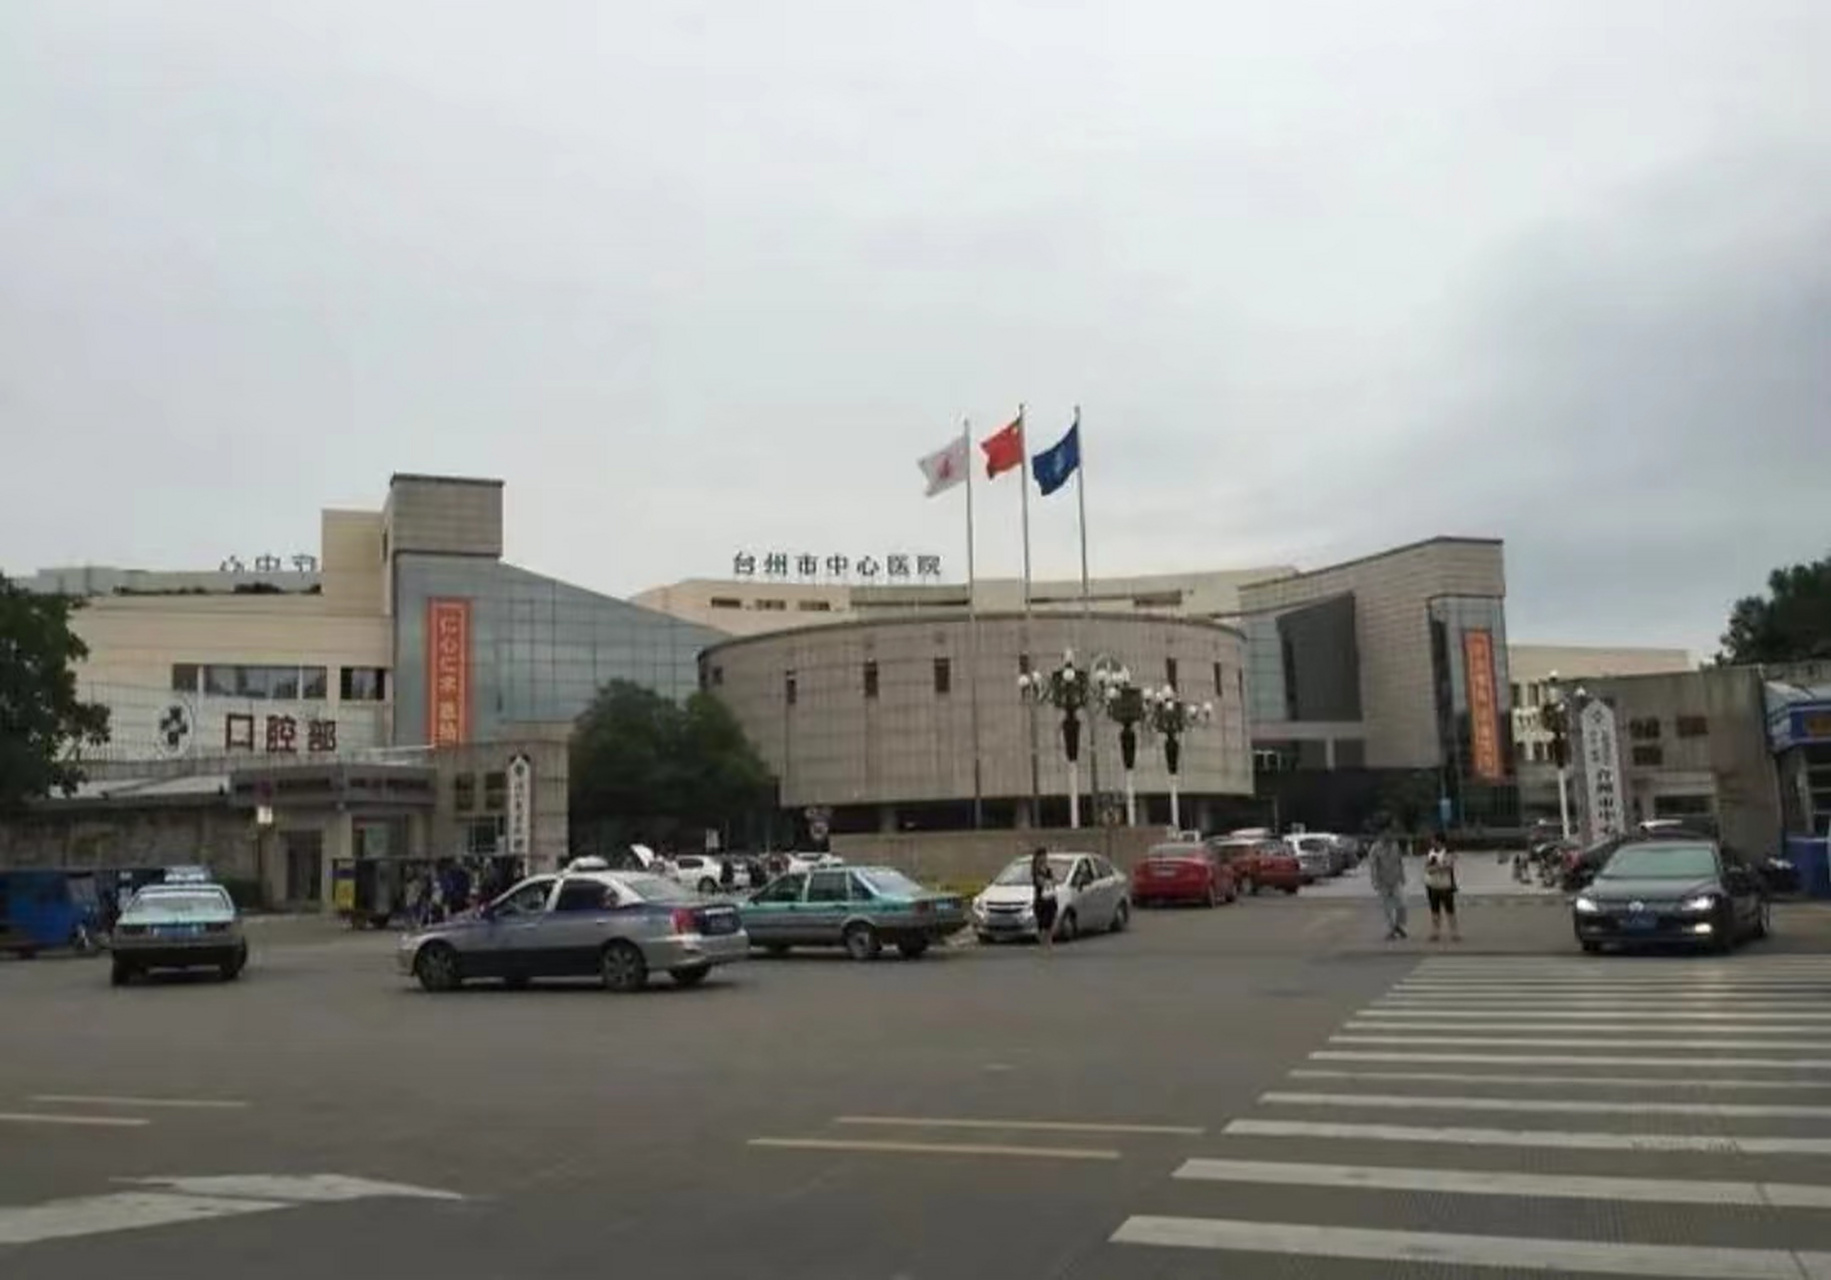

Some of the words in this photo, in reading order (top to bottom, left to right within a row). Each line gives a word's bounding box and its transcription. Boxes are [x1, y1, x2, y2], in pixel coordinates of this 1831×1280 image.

[733, 551, 942, 577] 台州市中心医院
[225, 713, 337, 753] 口腔部
